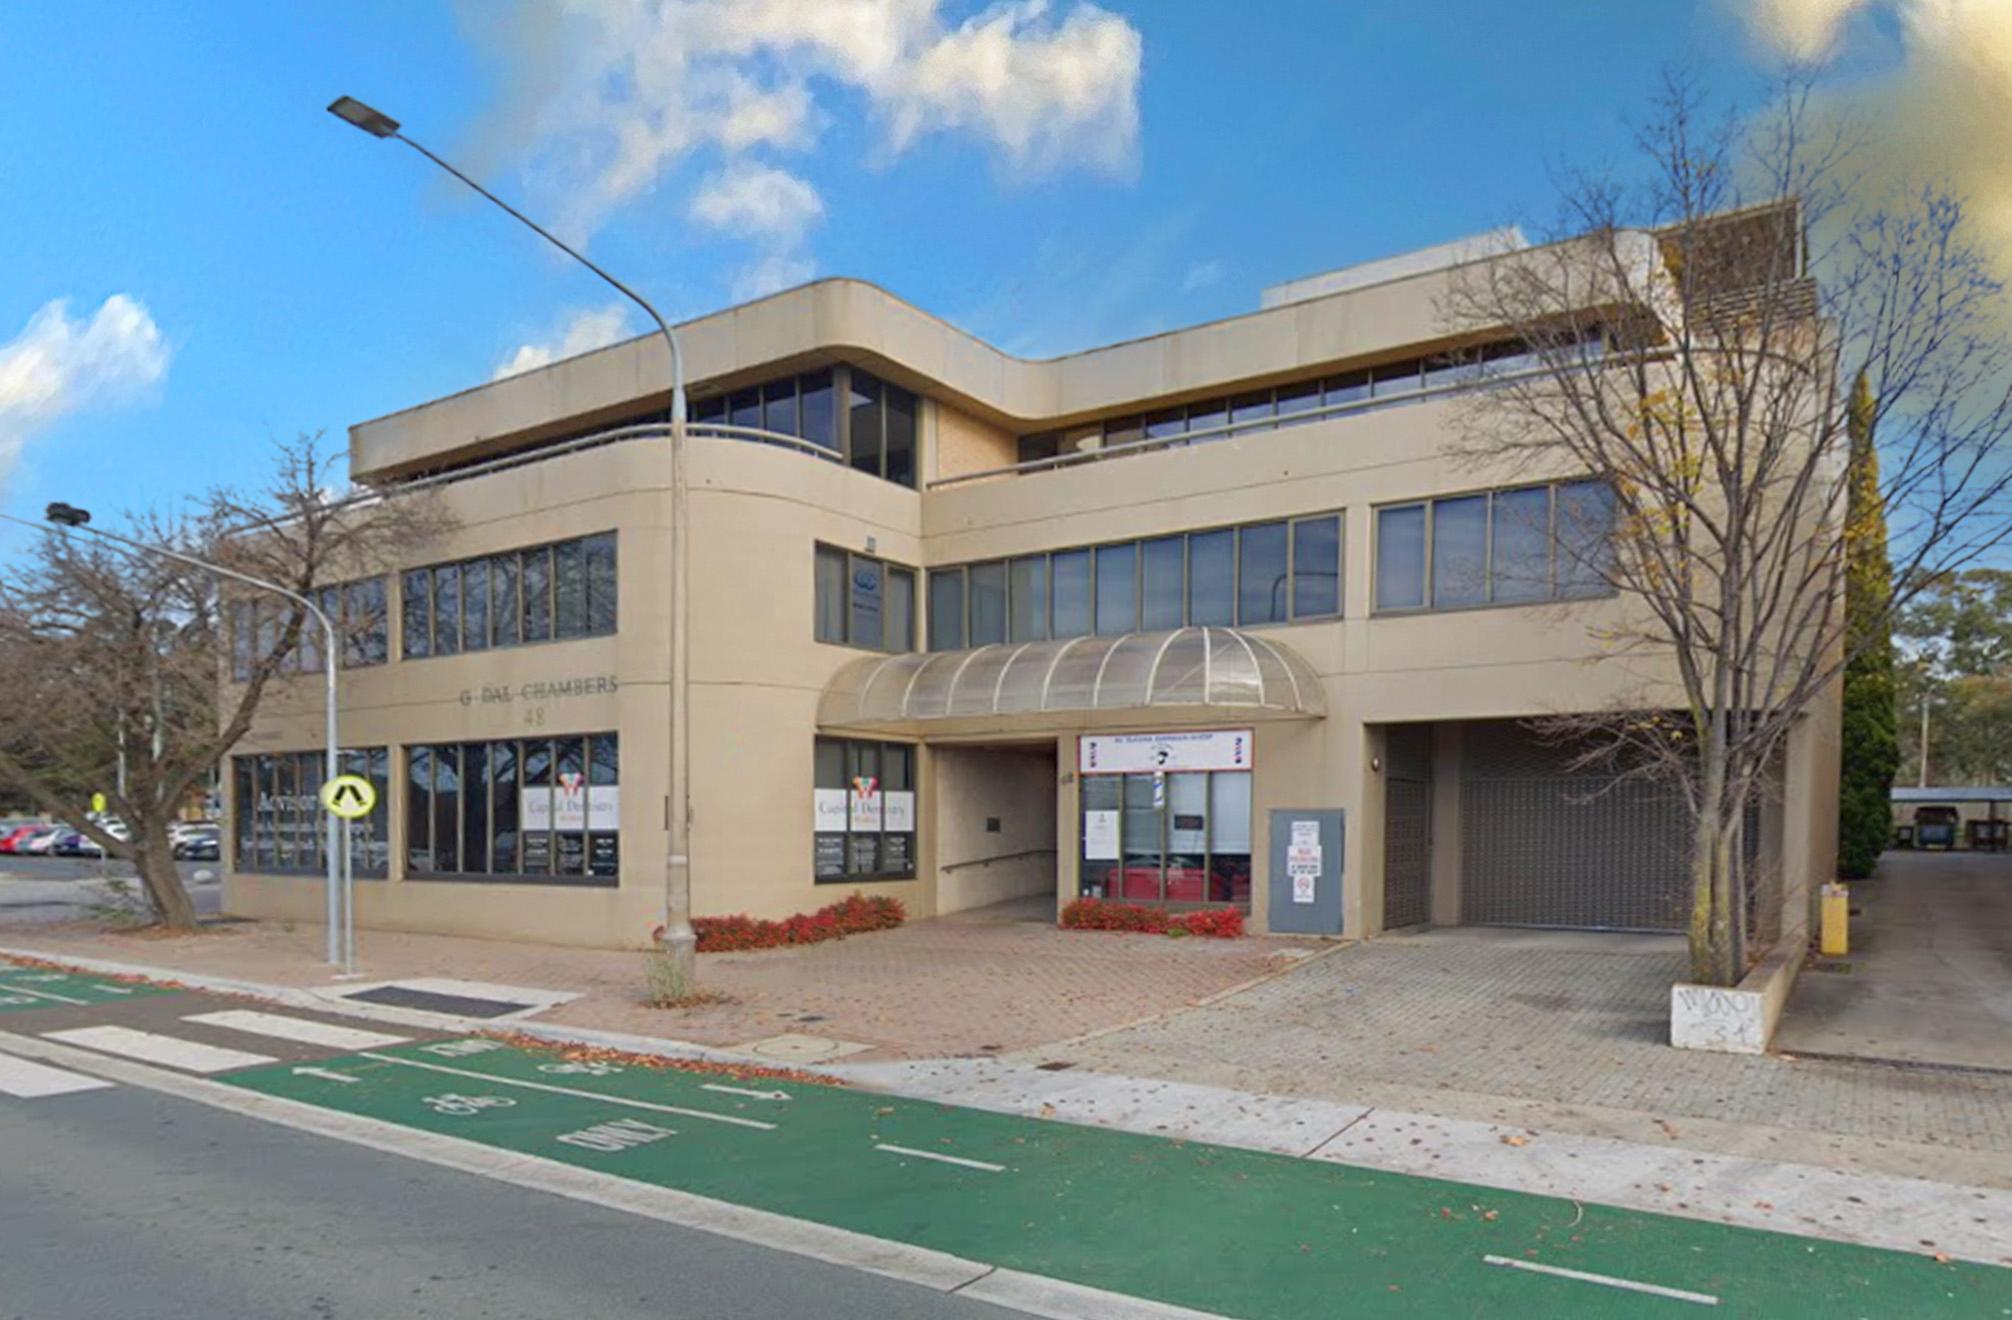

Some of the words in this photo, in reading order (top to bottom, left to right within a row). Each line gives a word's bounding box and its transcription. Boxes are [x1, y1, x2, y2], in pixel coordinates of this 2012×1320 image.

[520, 674, 618, 700] CHAMBERS
[567, 800, 613, 813] Denstry
[818, 800, 858, 816] Capial
[862, 800, 905, 816] Denstry
[556, 1118, 678, 1152] ONLY
